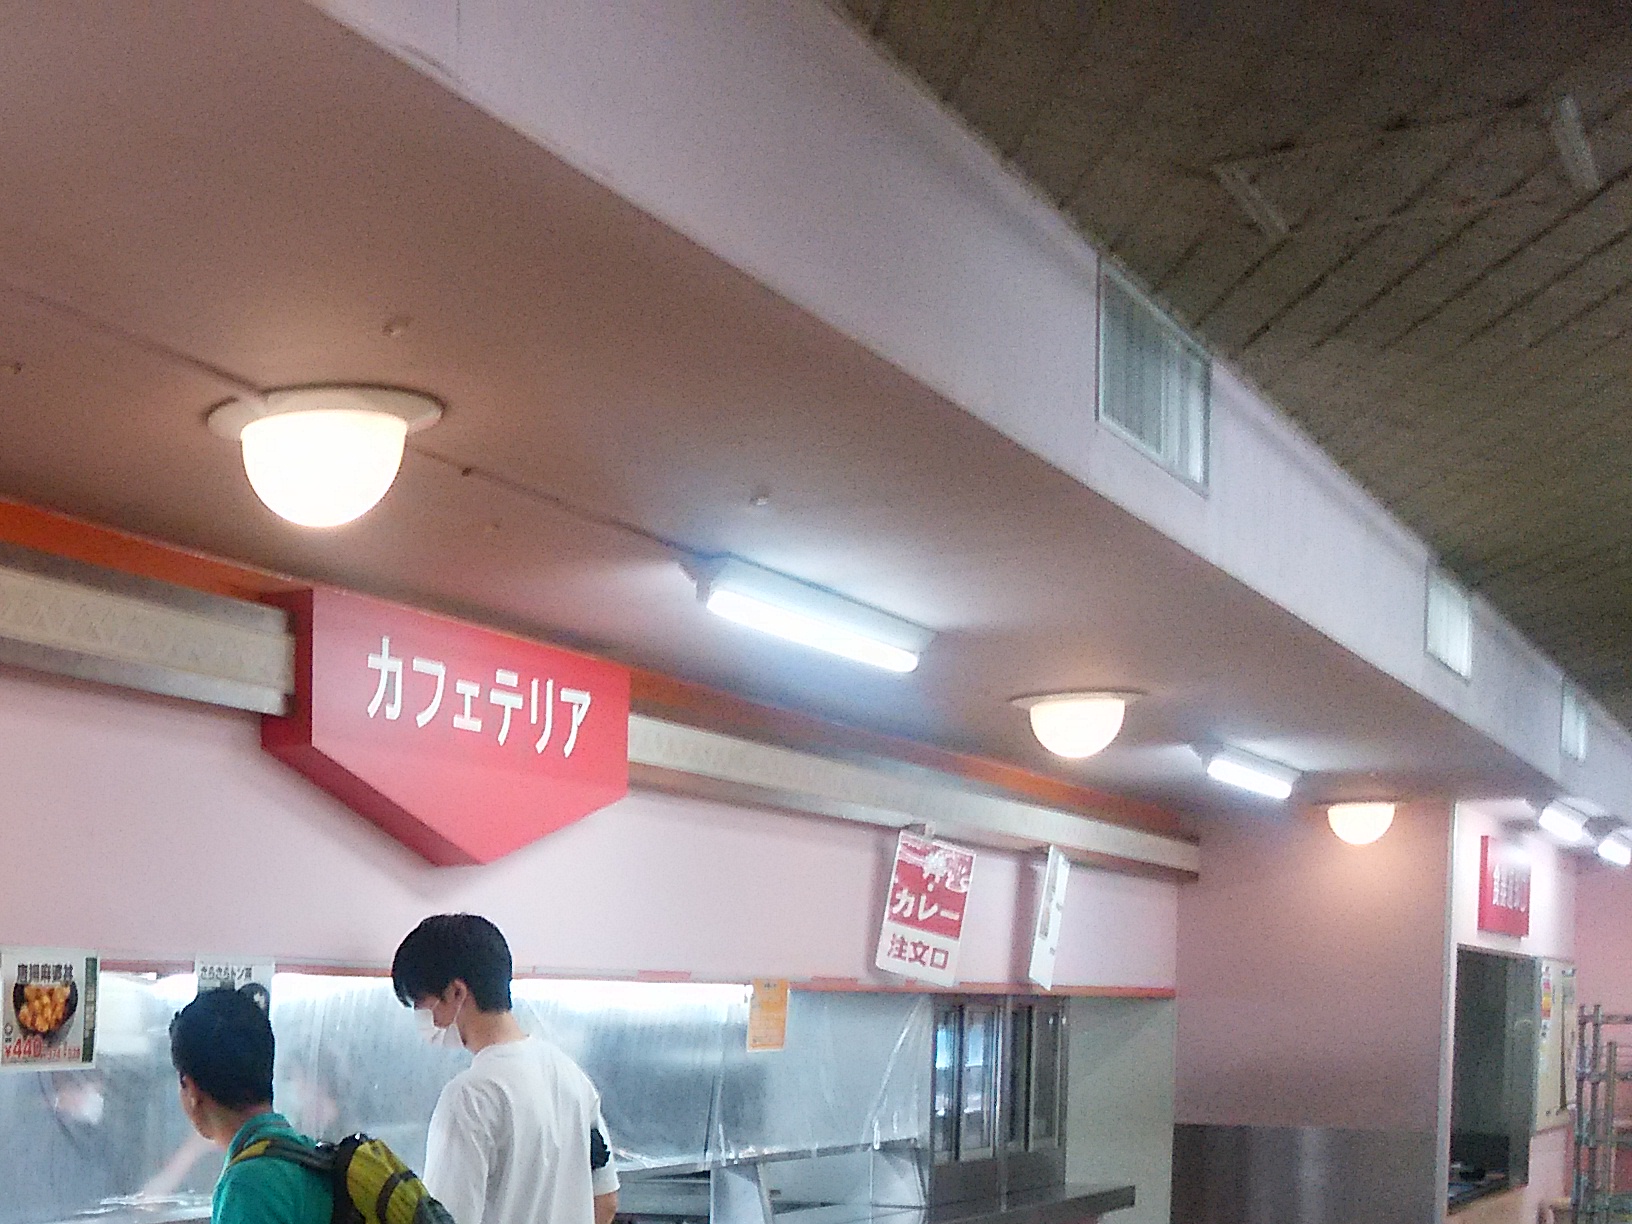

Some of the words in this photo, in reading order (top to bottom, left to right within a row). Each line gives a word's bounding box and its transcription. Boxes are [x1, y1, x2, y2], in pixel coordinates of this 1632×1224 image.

[366, 635, 592, 759] カフェテリア
[891, 887, 961, 922] カレー
[887, 933, 950, 970] 注文口
[4, 1038, 42, 1060] ¥440
